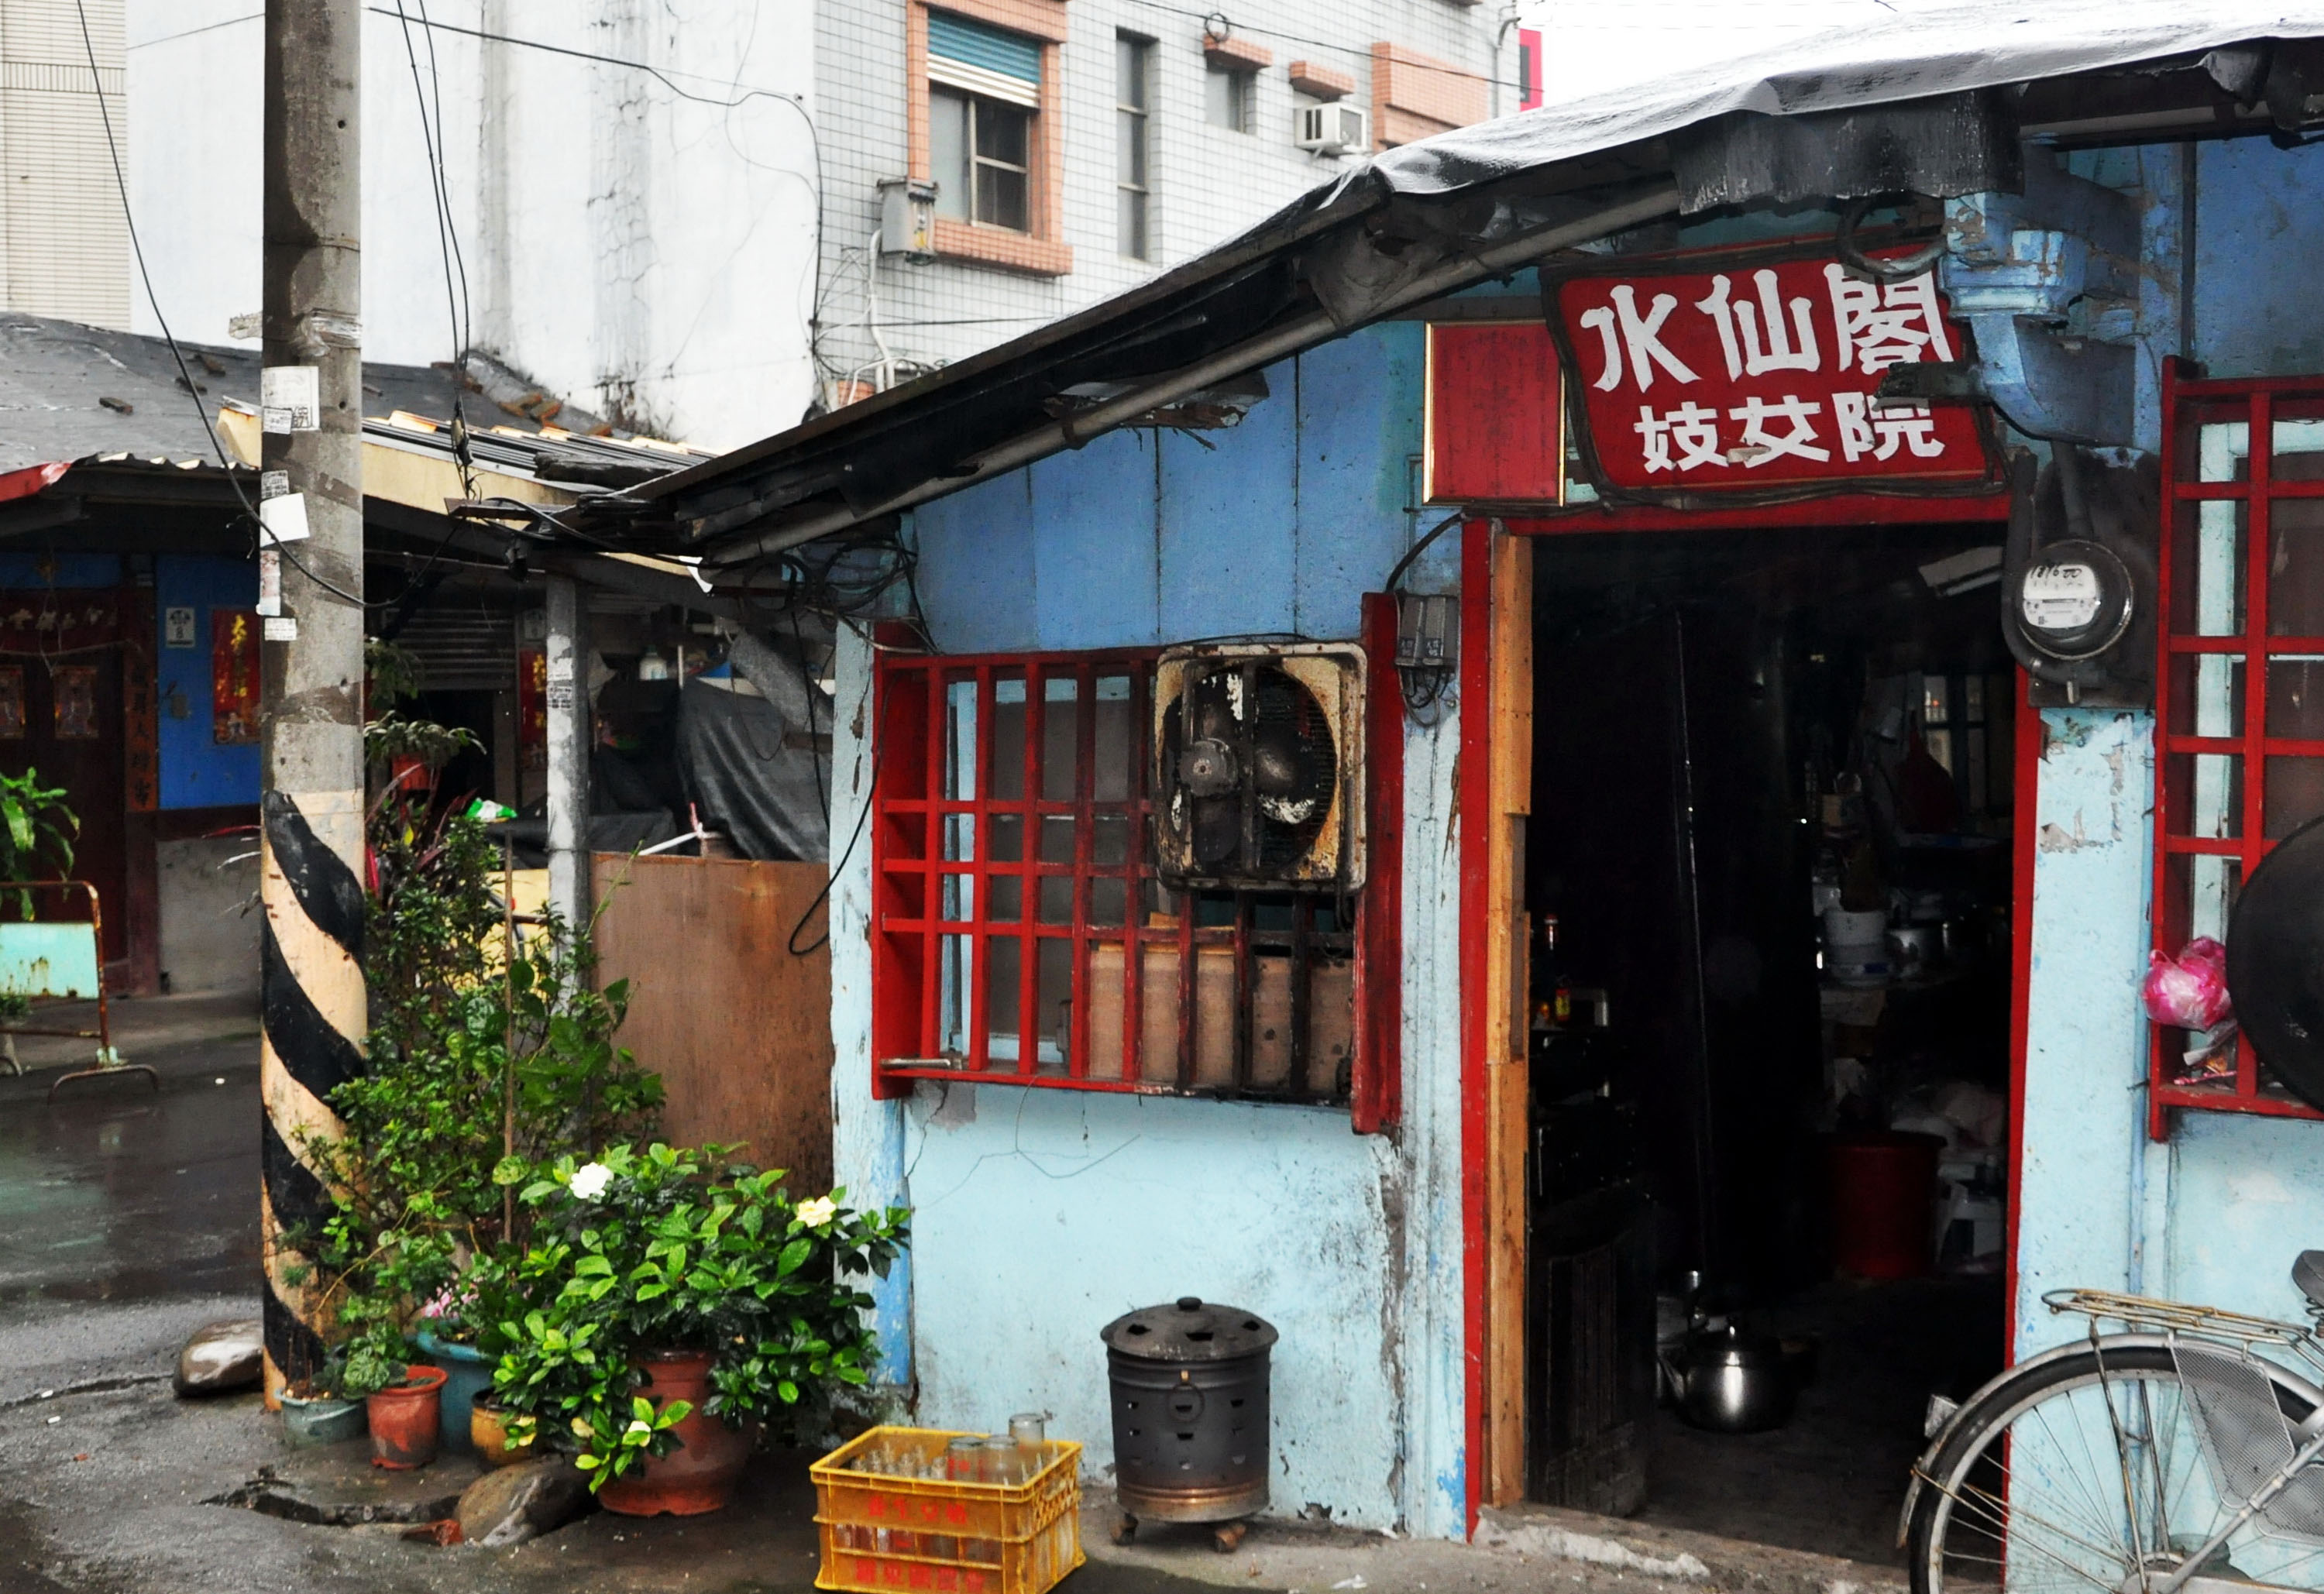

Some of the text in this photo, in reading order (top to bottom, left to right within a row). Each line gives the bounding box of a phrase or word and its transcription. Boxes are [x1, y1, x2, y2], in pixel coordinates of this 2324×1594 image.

[1580, 260, 1954, 393] 水仙閣
[1633, 391, 1946, 474] 妓女院
